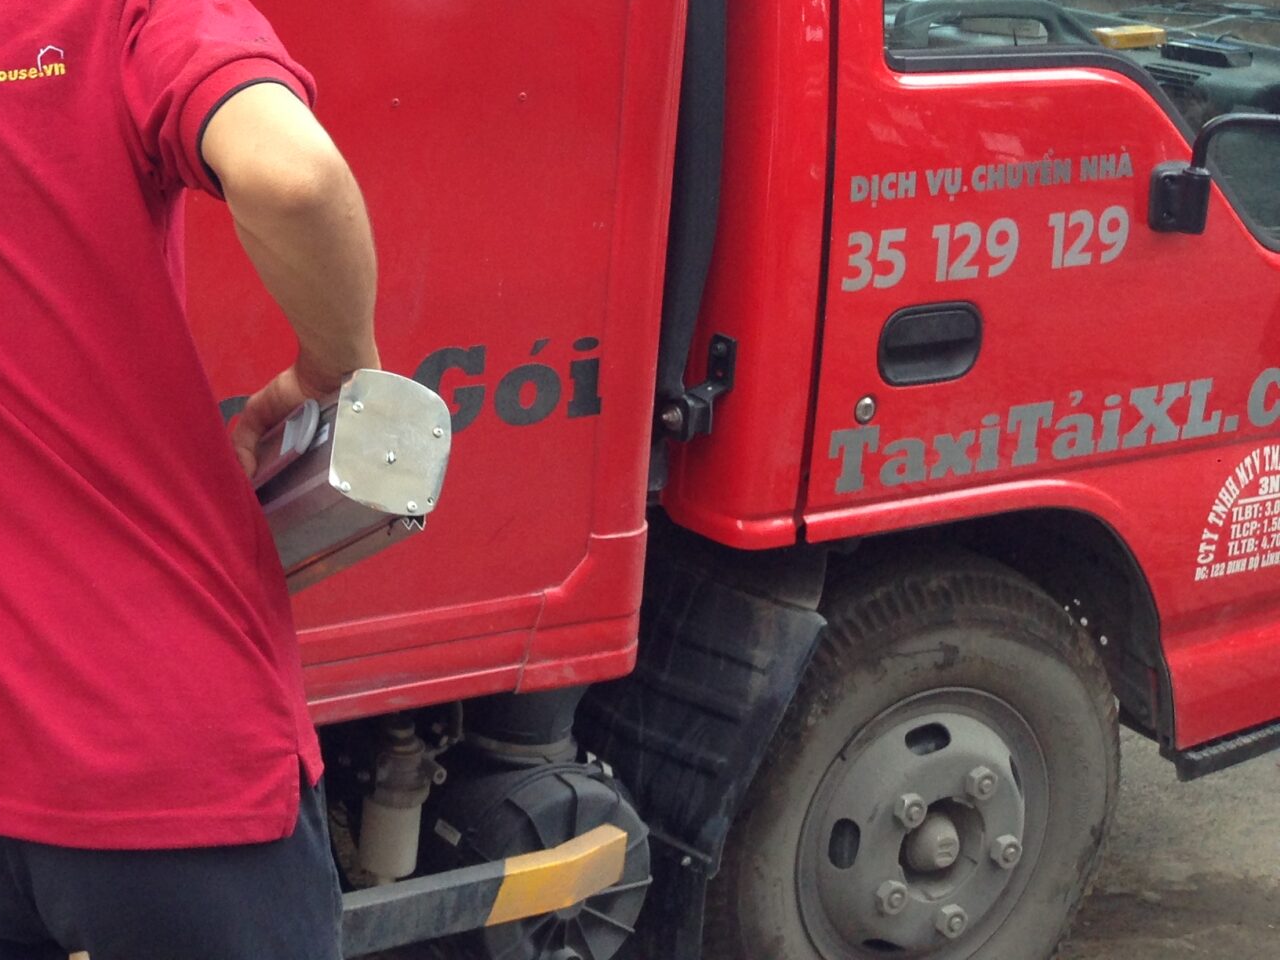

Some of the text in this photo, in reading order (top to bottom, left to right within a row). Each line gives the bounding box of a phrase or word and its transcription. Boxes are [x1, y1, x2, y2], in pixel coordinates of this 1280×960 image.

[850, 171, 916, 208] DỊCH
[1079, 145, 1134, 182] NHÀ
[841, 205, 1130, 292] 35 129 129
[1208, 476, 1240, 527] TNHH
[1235, 448, 1260, 488] MTV
[1230, 520, 1261, 540] TLCP:
[1231, 503, 1263, 523] TLBT:
[1228, 537, 1259, 556] TLTB:
